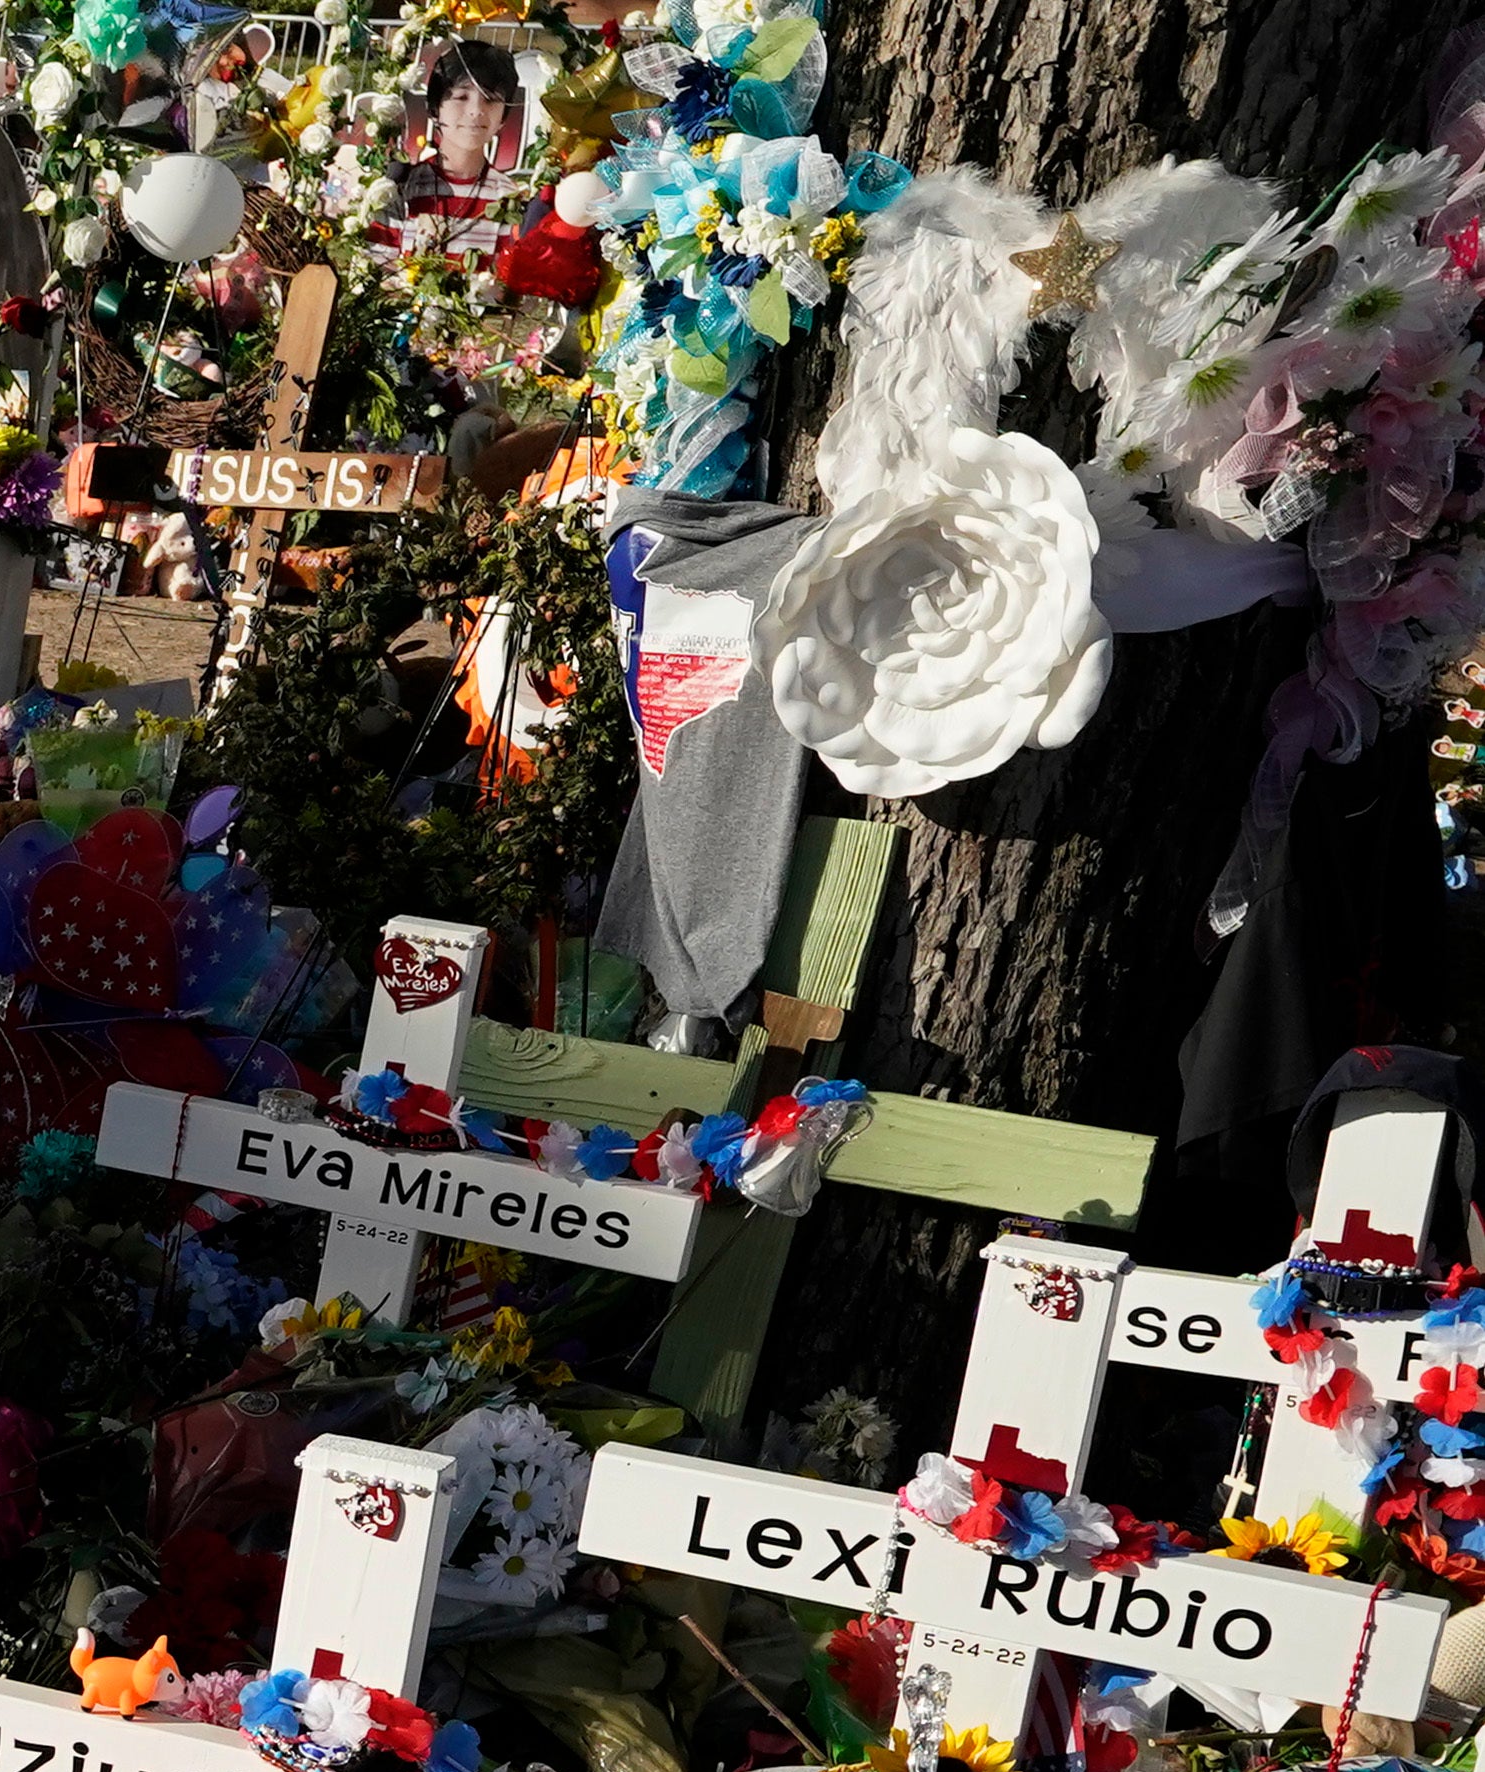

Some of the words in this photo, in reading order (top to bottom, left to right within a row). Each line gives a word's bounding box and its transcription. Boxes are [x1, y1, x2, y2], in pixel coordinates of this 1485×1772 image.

[153, 452, 298, 505] JESUS
[323, 457, 367, 508] IS
[382, 974, 450, 994] Mireles
[392, 957, 434, 981] Eva
[238, 1128, 351, 1190] Eva
[379, 1158, 632, 1252] Mireles
[334, 1215, 411, 1246] 5-24-22
[685, 1493, 916, 1598] Lexi
[981, 1563, 1275, 1662] Rubio
[922, 1631, 1028, 1667] 5-24-22
